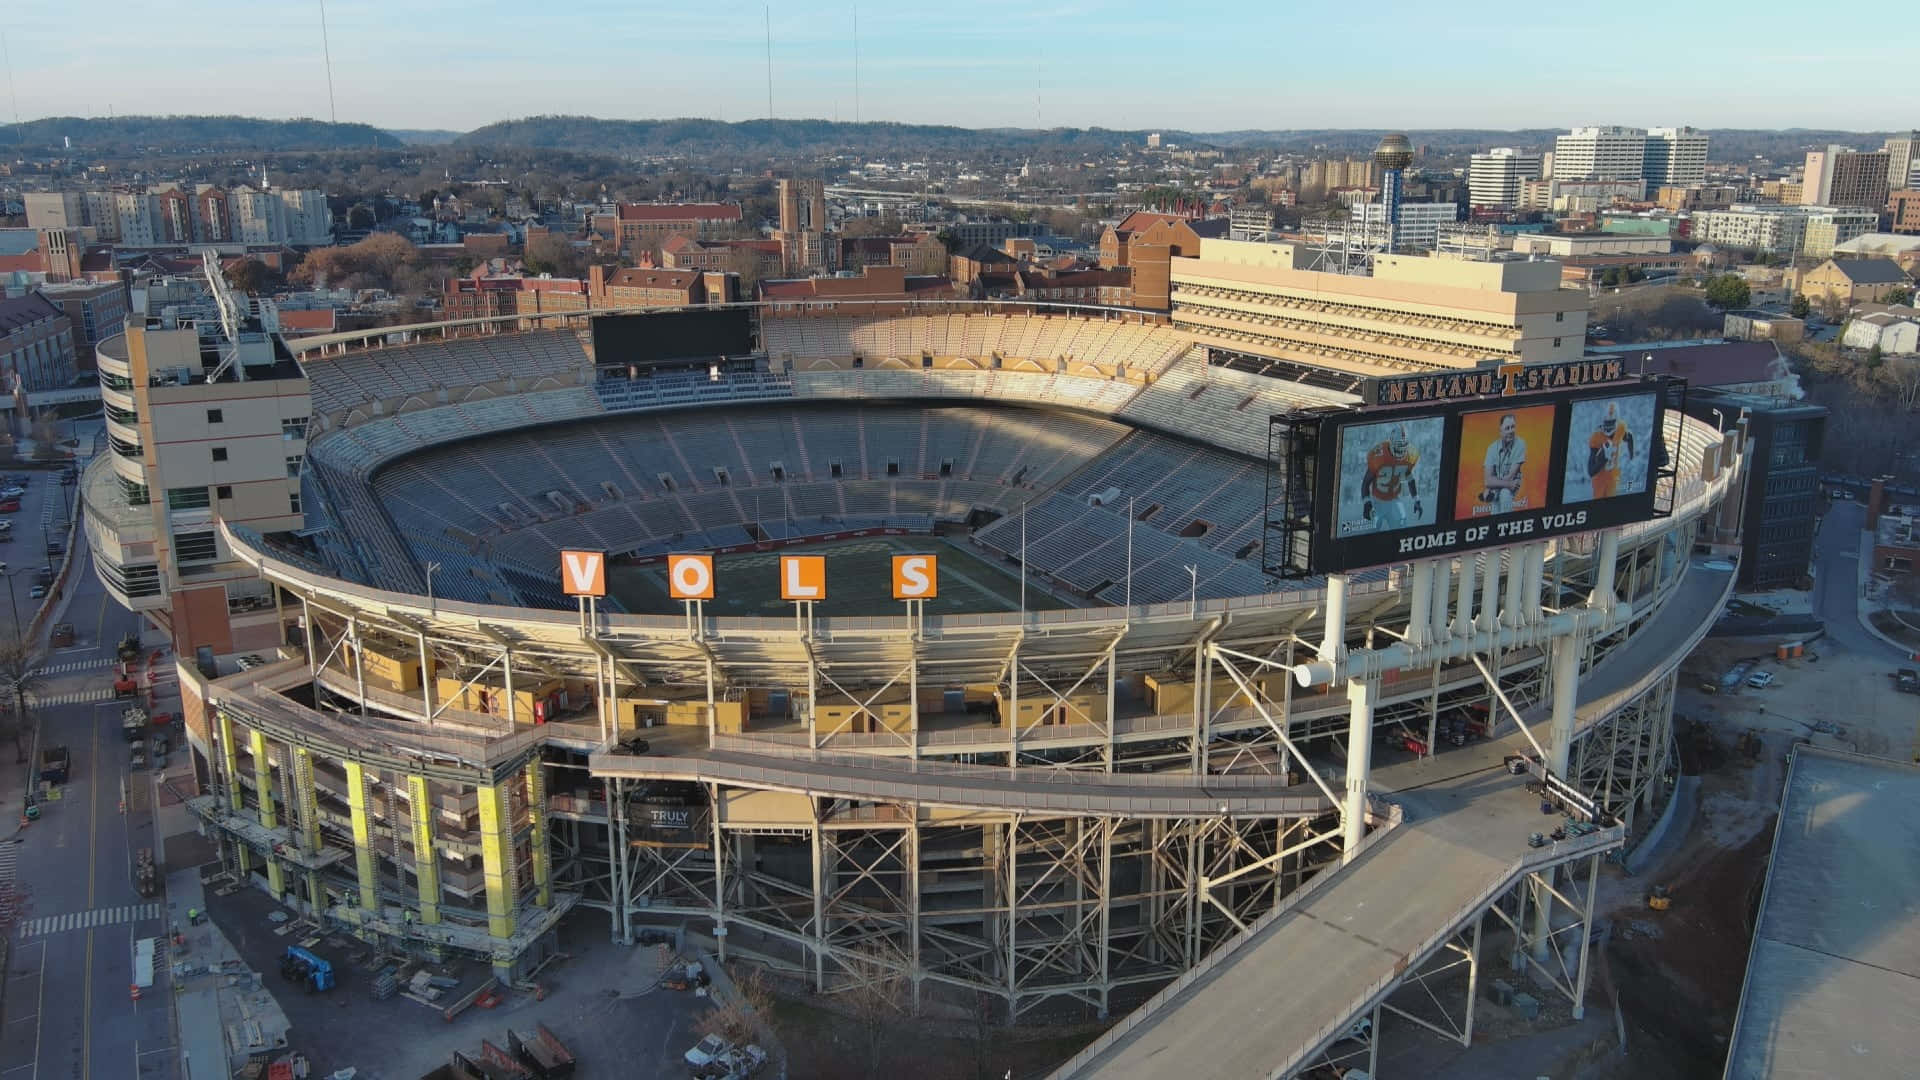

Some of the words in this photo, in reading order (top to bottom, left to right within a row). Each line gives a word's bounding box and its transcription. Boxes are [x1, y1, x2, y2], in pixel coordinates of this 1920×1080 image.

[1389, 374, 1493, 401] NEYLAND
[1498, 365, 1524, 397] T
[1527, 361, 1621, 388] STADIUM
[1399, 531, 1457, 553] HOME
[1465, 525, 1490, 542] OF
[1497, 519, 1534, 537] THE
[1542, 511, 1587, 530] VOLS
[651, 810, 688, 821] TRULY
